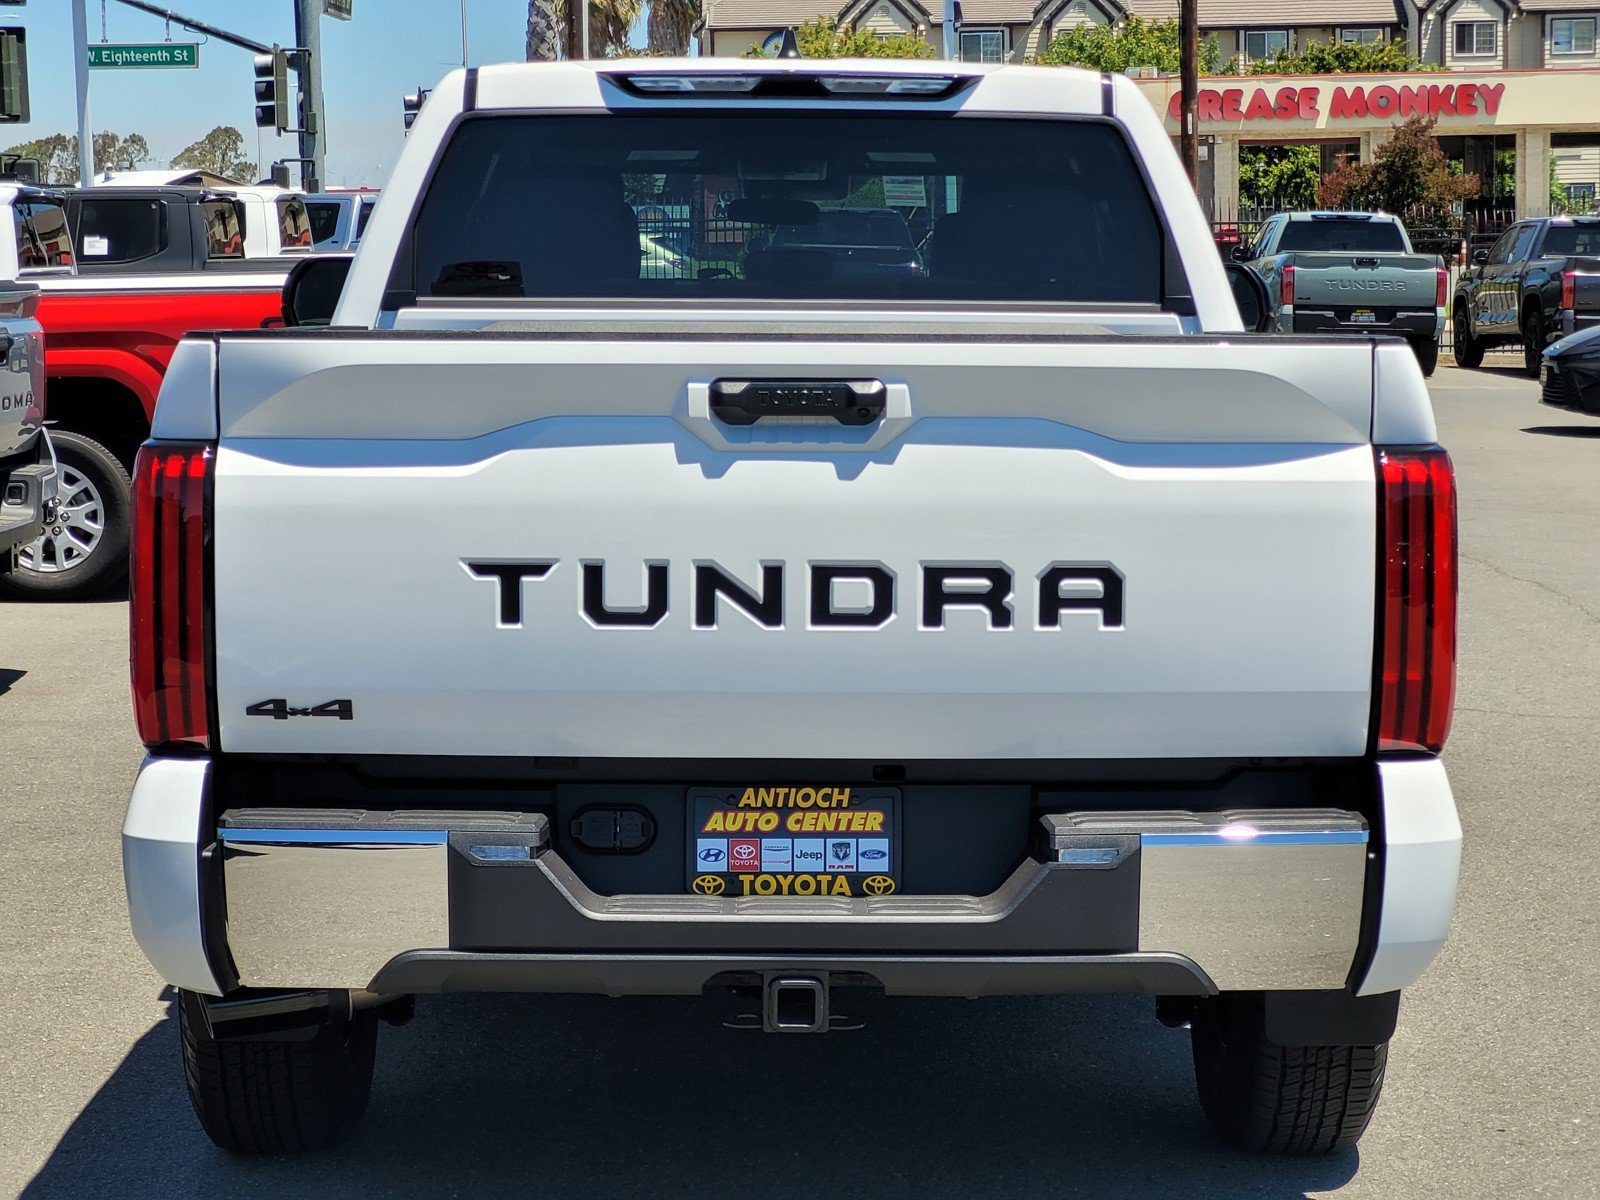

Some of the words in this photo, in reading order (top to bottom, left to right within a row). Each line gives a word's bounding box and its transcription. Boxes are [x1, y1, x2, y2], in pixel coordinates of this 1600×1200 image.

[102, 50, 169, 65] Eighteenth
[174, 50, 188, 61] St
[1330, 83, 1505, 118] MONKEY
[1325, 280, 1408, 291] TUNDRA
[757, 390, 839, 406] TOYOTA
[458, 559, 1126, 632] TUNDRA
[245, 698, 353, 719] 4x4
[738, 787, 850, 808] ANTIOCH
[703, 811, 780, 832] AUTO
[786, 811, 885, 832] CENTER
[795, 849, 823, 861] Jeep
[864, 850, 883, 859] Ford
[739, 874, 852, 896] TOYOTA
